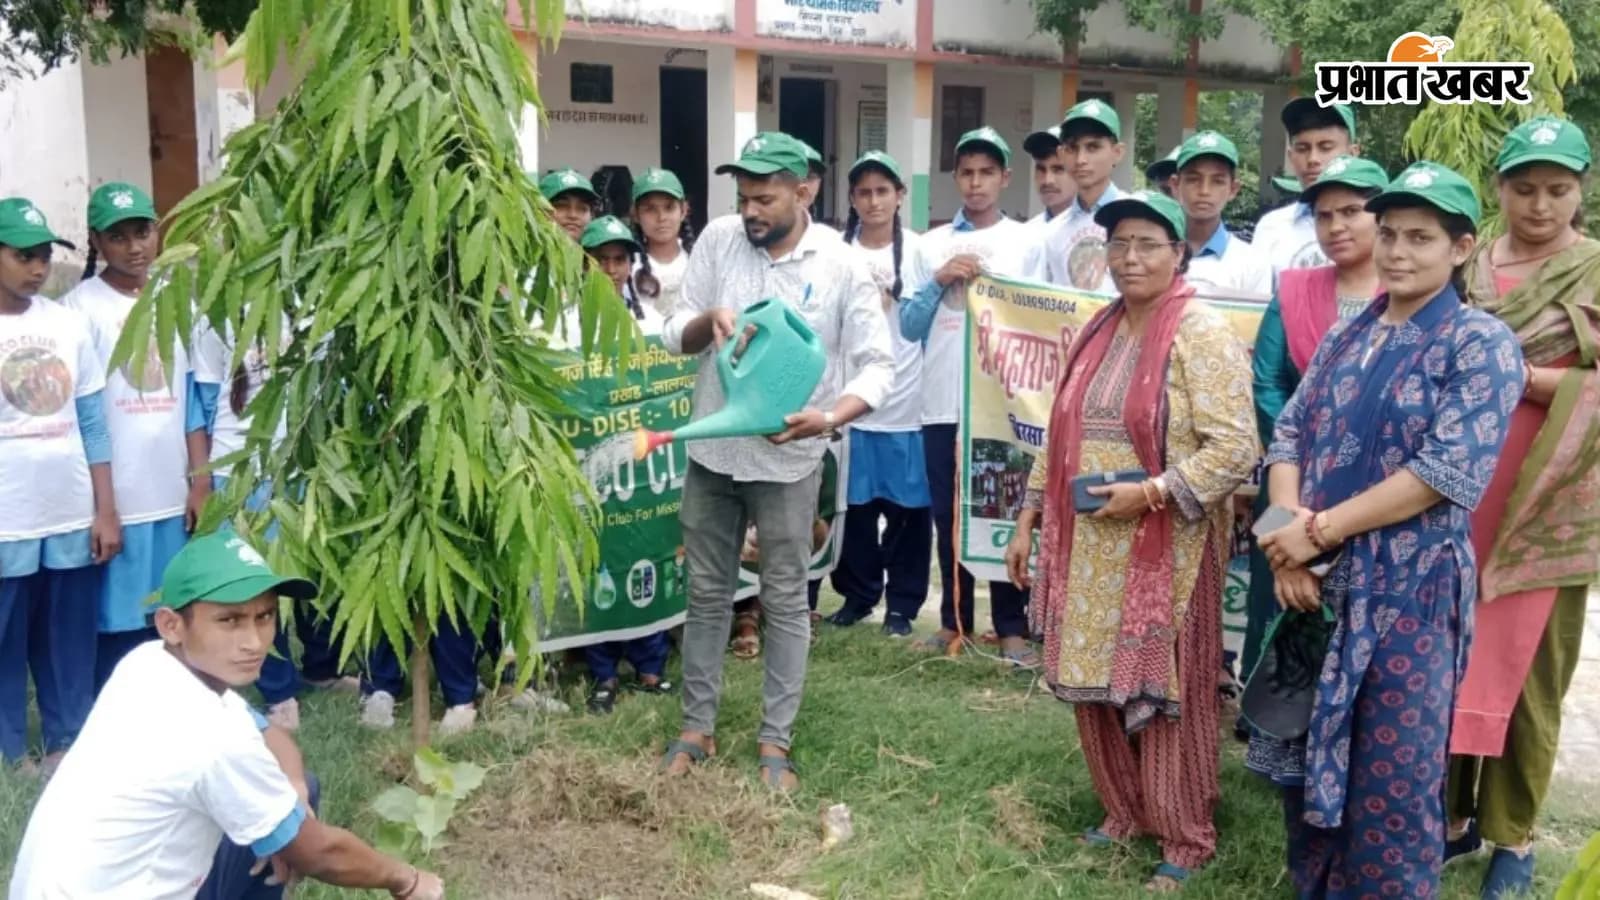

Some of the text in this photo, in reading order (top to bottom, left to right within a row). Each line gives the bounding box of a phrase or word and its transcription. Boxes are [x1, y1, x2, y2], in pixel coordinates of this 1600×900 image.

[993, 328, 1061, 400] महाराज
[562, 407, 641, 438] U-DISE
[648, 440, 689, 496] CL
[607, 511, 633, 526] Club
[635, 507, 654, 521] For
[656, 501, 681, 517] Miss
